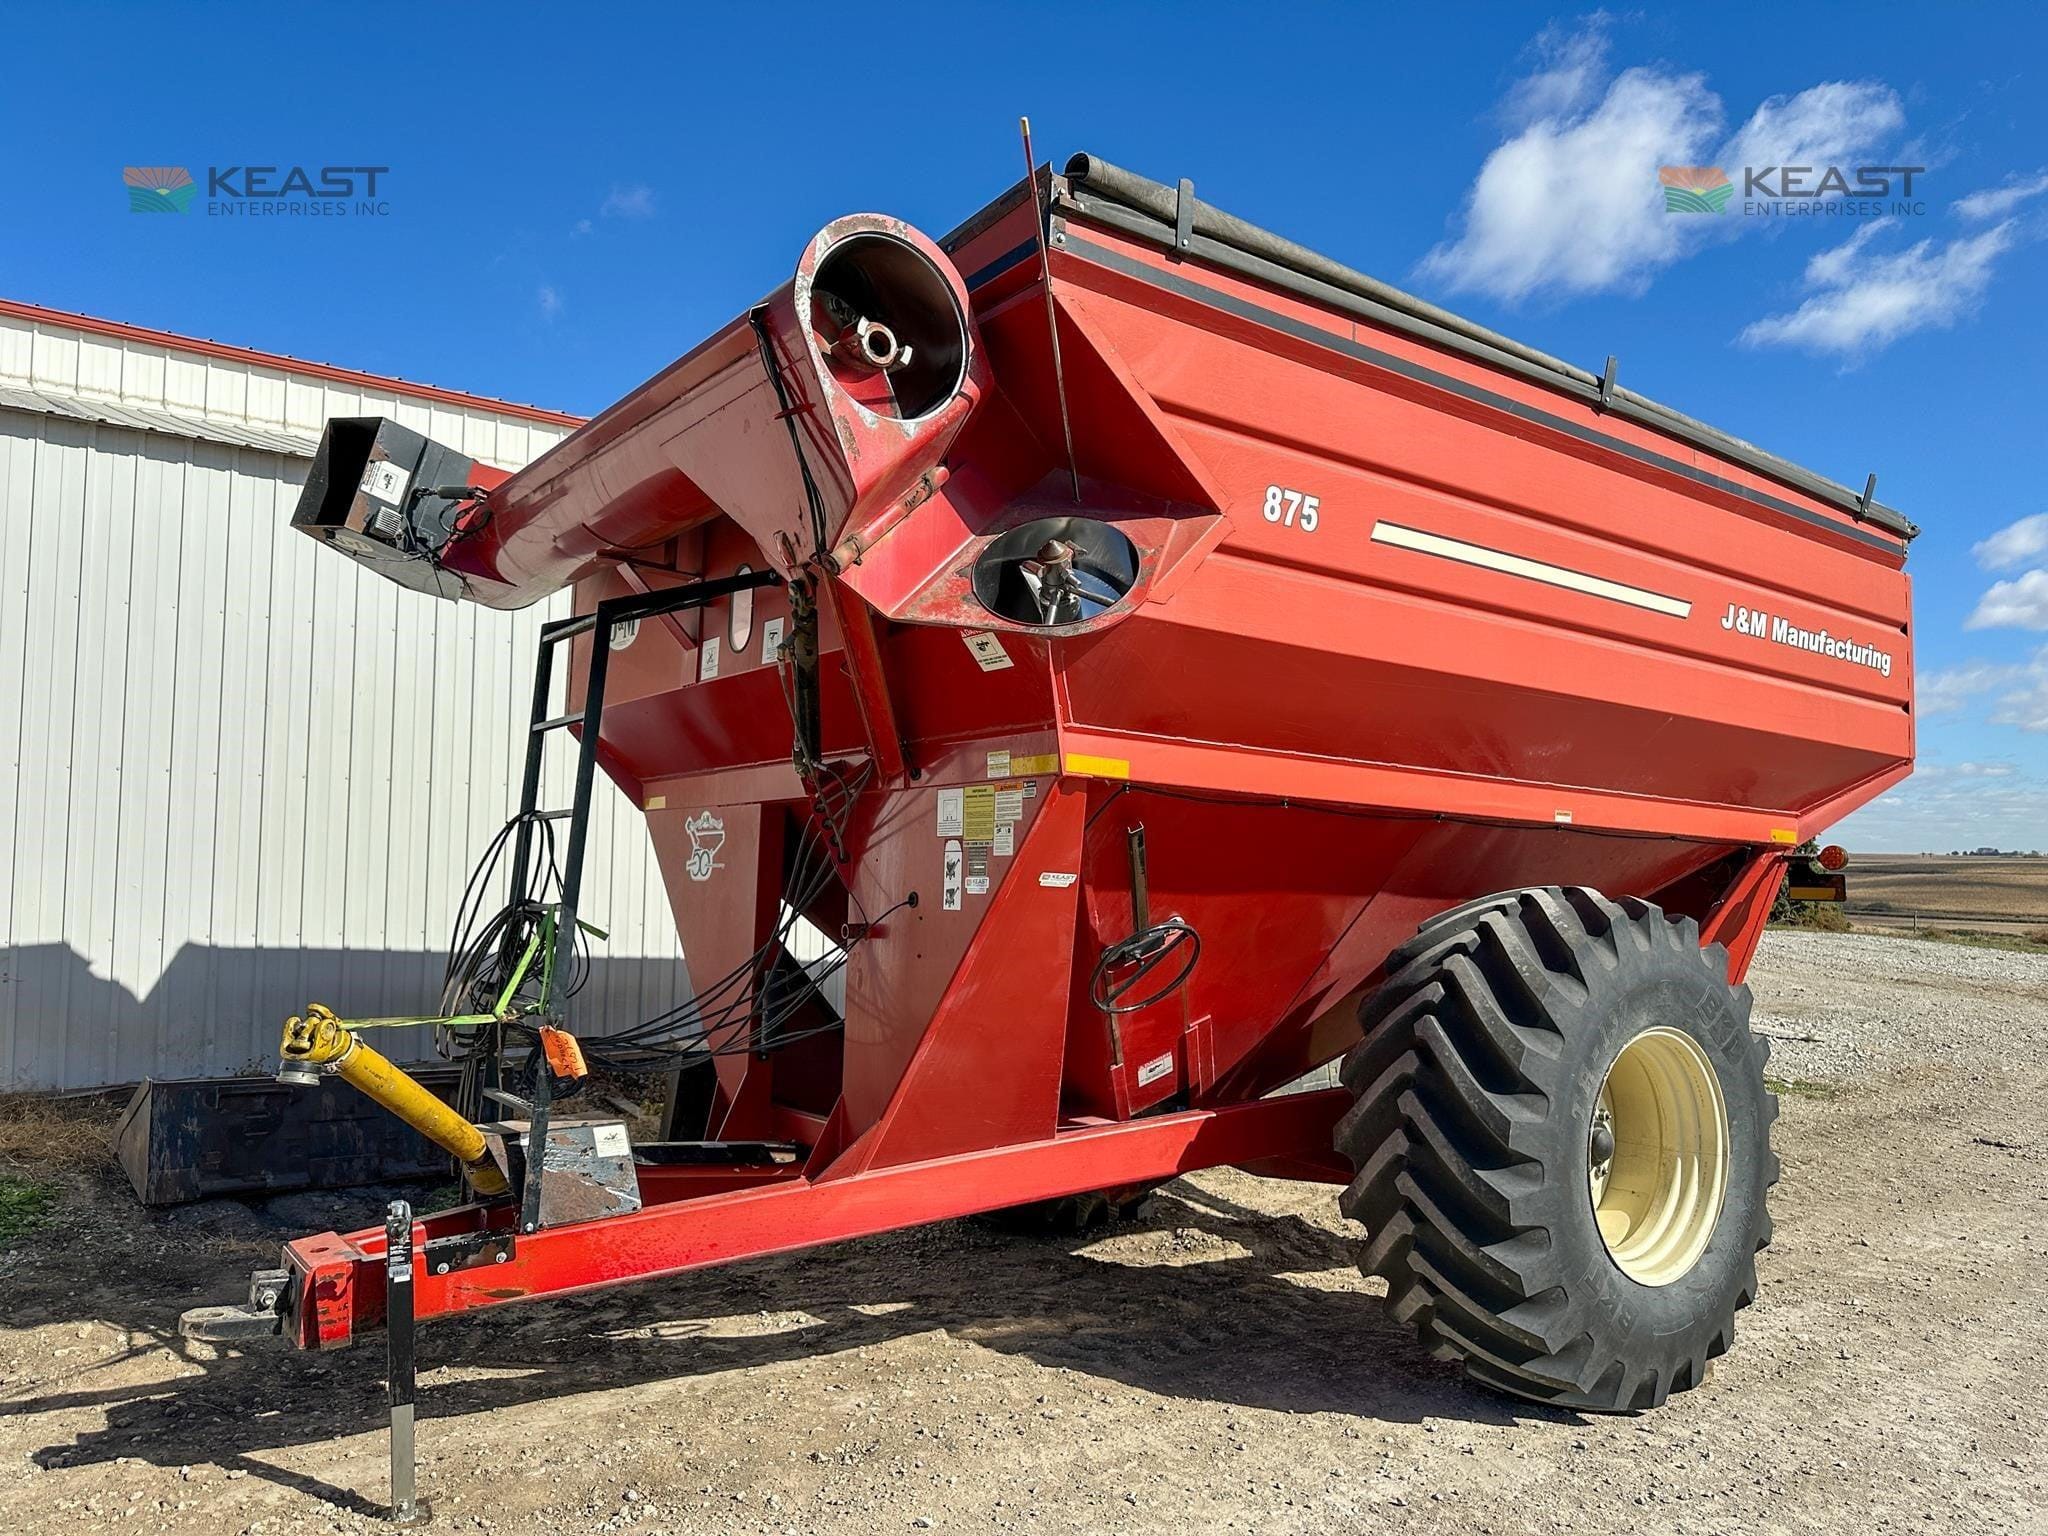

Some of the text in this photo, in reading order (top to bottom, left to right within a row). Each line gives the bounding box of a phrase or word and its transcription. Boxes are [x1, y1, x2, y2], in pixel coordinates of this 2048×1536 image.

[1263, 484, 1320, 533] 875
[1721, 602, 1892, 678] J&M Manufacturing
